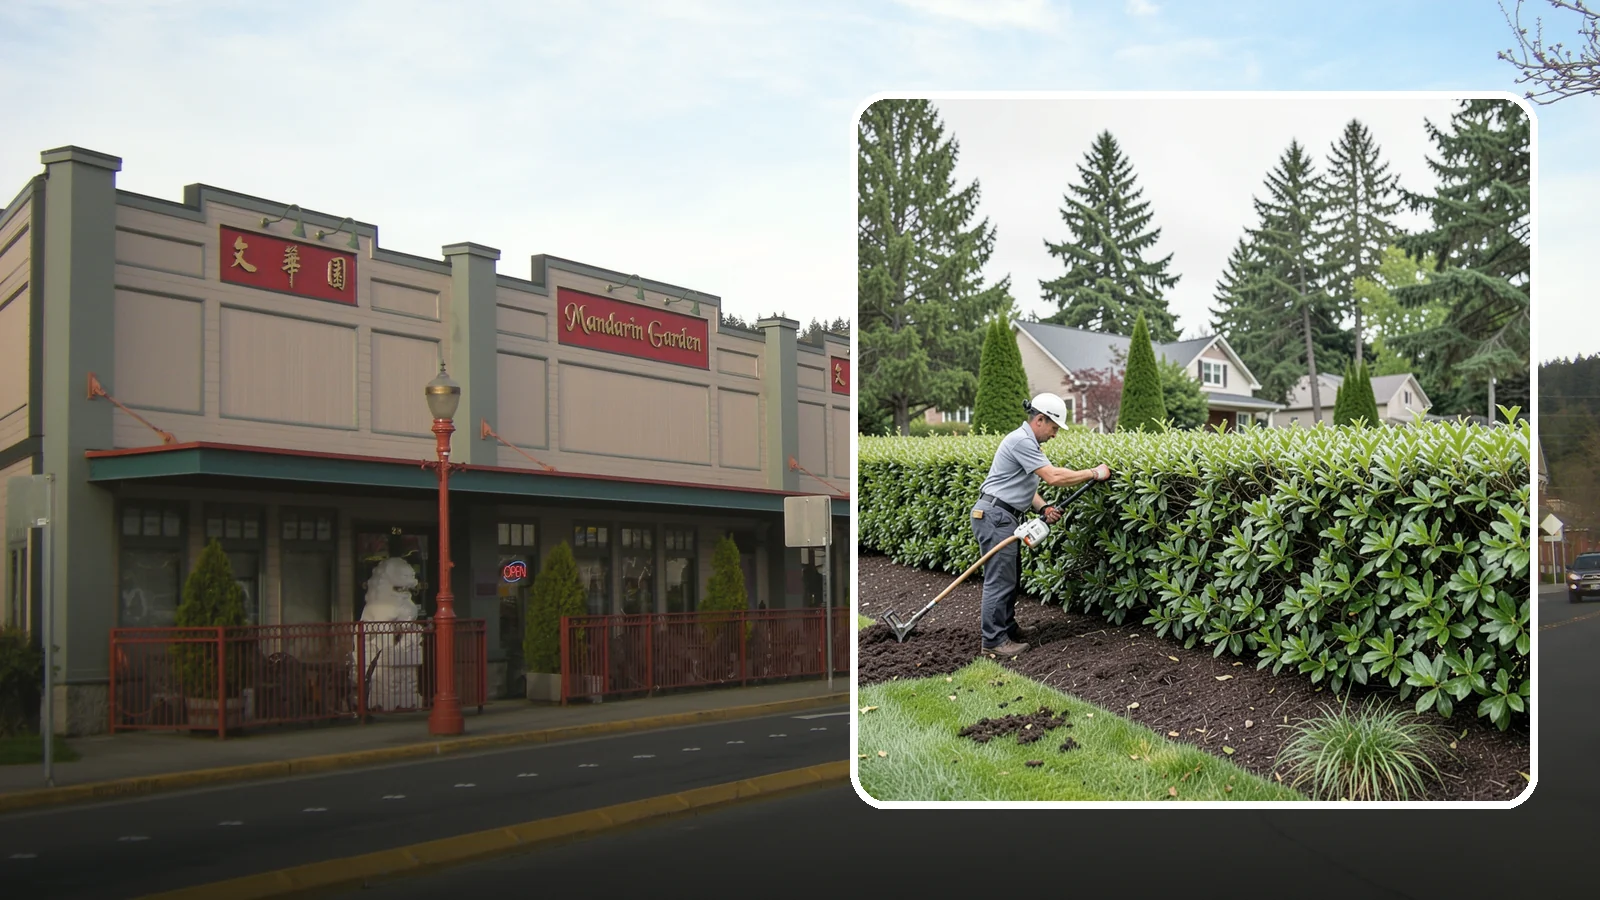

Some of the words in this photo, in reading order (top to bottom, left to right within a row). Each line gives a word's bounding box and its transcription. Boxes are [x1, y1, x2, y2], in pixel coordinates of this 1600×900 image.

[230, 235, 346, 291] 文華園
[565, 302, 643, 341] Mandarin
[648, 320, 701, 352] Garden
[503, 565, 527, 578] OPEN
